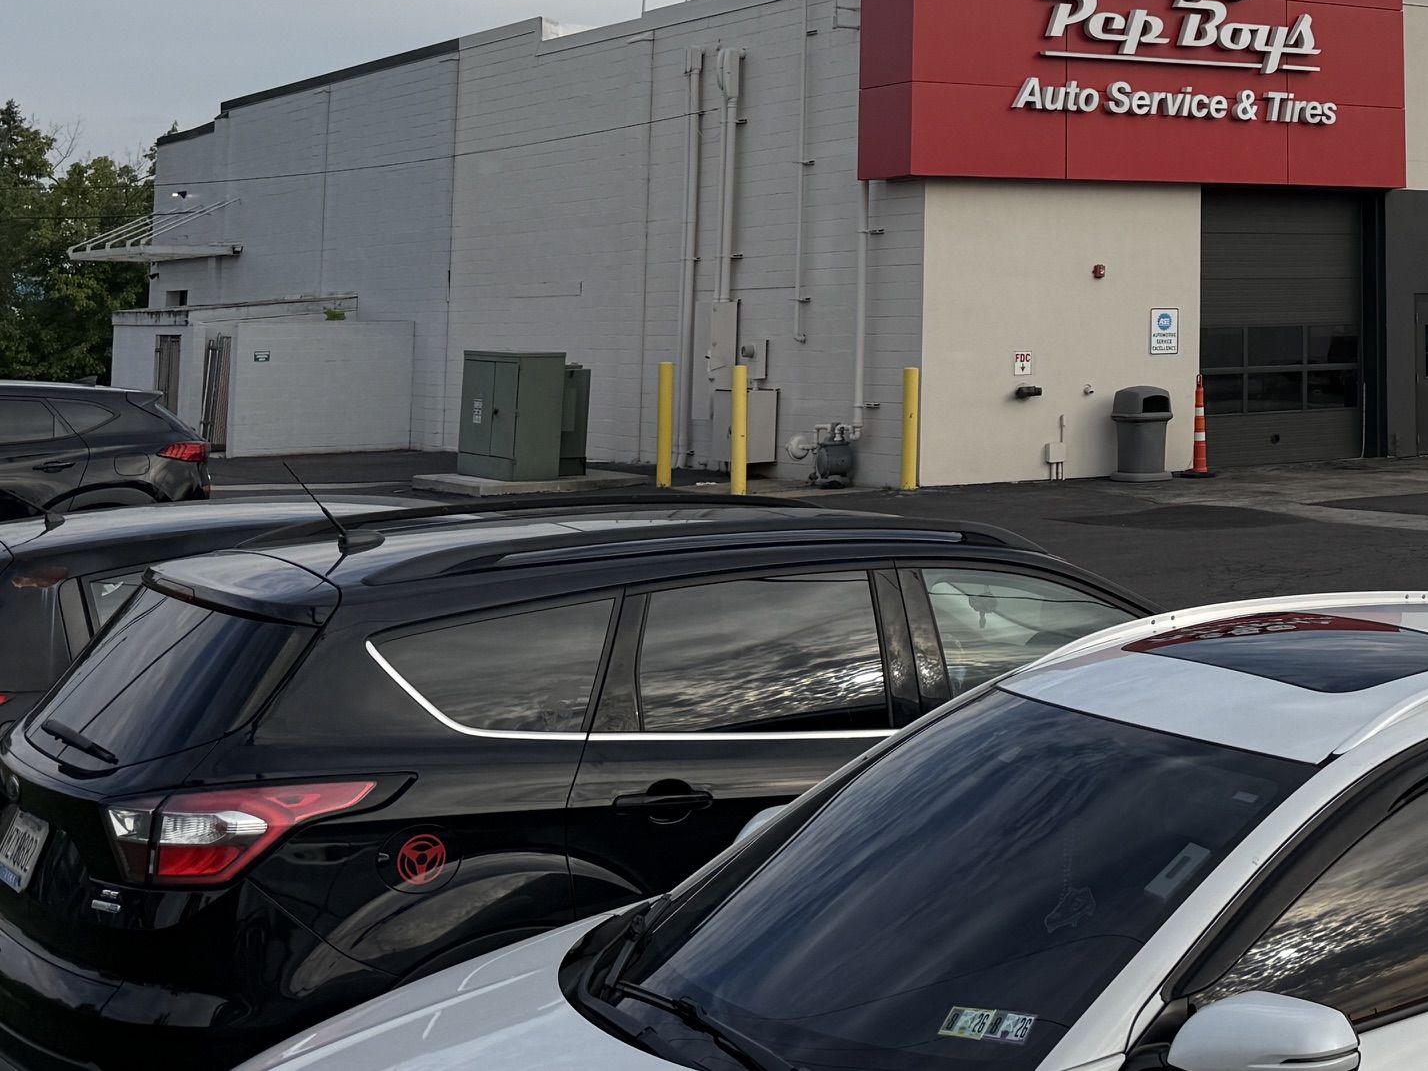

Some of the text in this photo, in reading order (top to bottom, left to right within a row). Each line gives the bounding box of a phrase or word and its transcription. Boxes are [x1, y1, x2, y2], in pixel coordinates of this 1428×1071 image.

[1011, 77, 1337, 125] Auto Service & Tires
[1015, 353, 1031, 363] FDC
[972, 1013, 990, 1033] 26
[1014, 1017, 1032, 1039] 26
